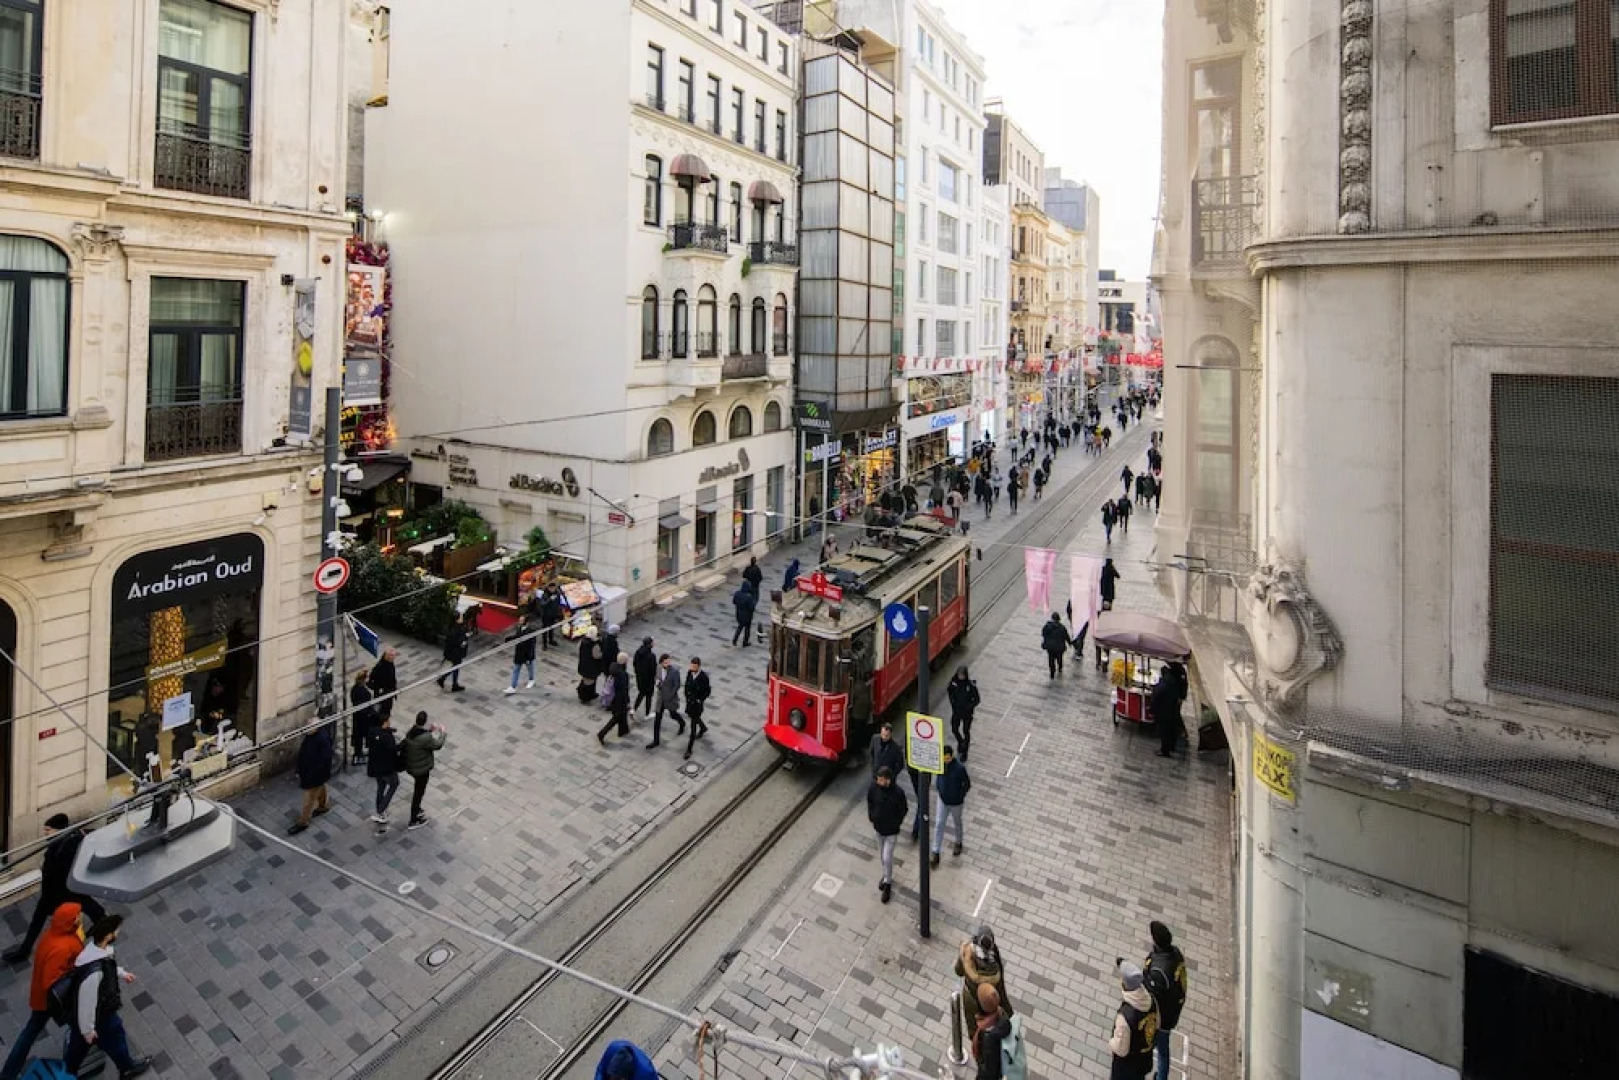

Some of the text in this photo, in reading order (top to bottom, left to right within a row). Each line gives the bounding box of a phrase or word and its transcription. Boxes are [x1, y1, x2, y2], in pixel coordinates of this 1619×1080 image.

[127, 571, 208, 600] Arabian
[215, 555, 252, 579] Oud
[1256, 756, 1286, 788] FAX
